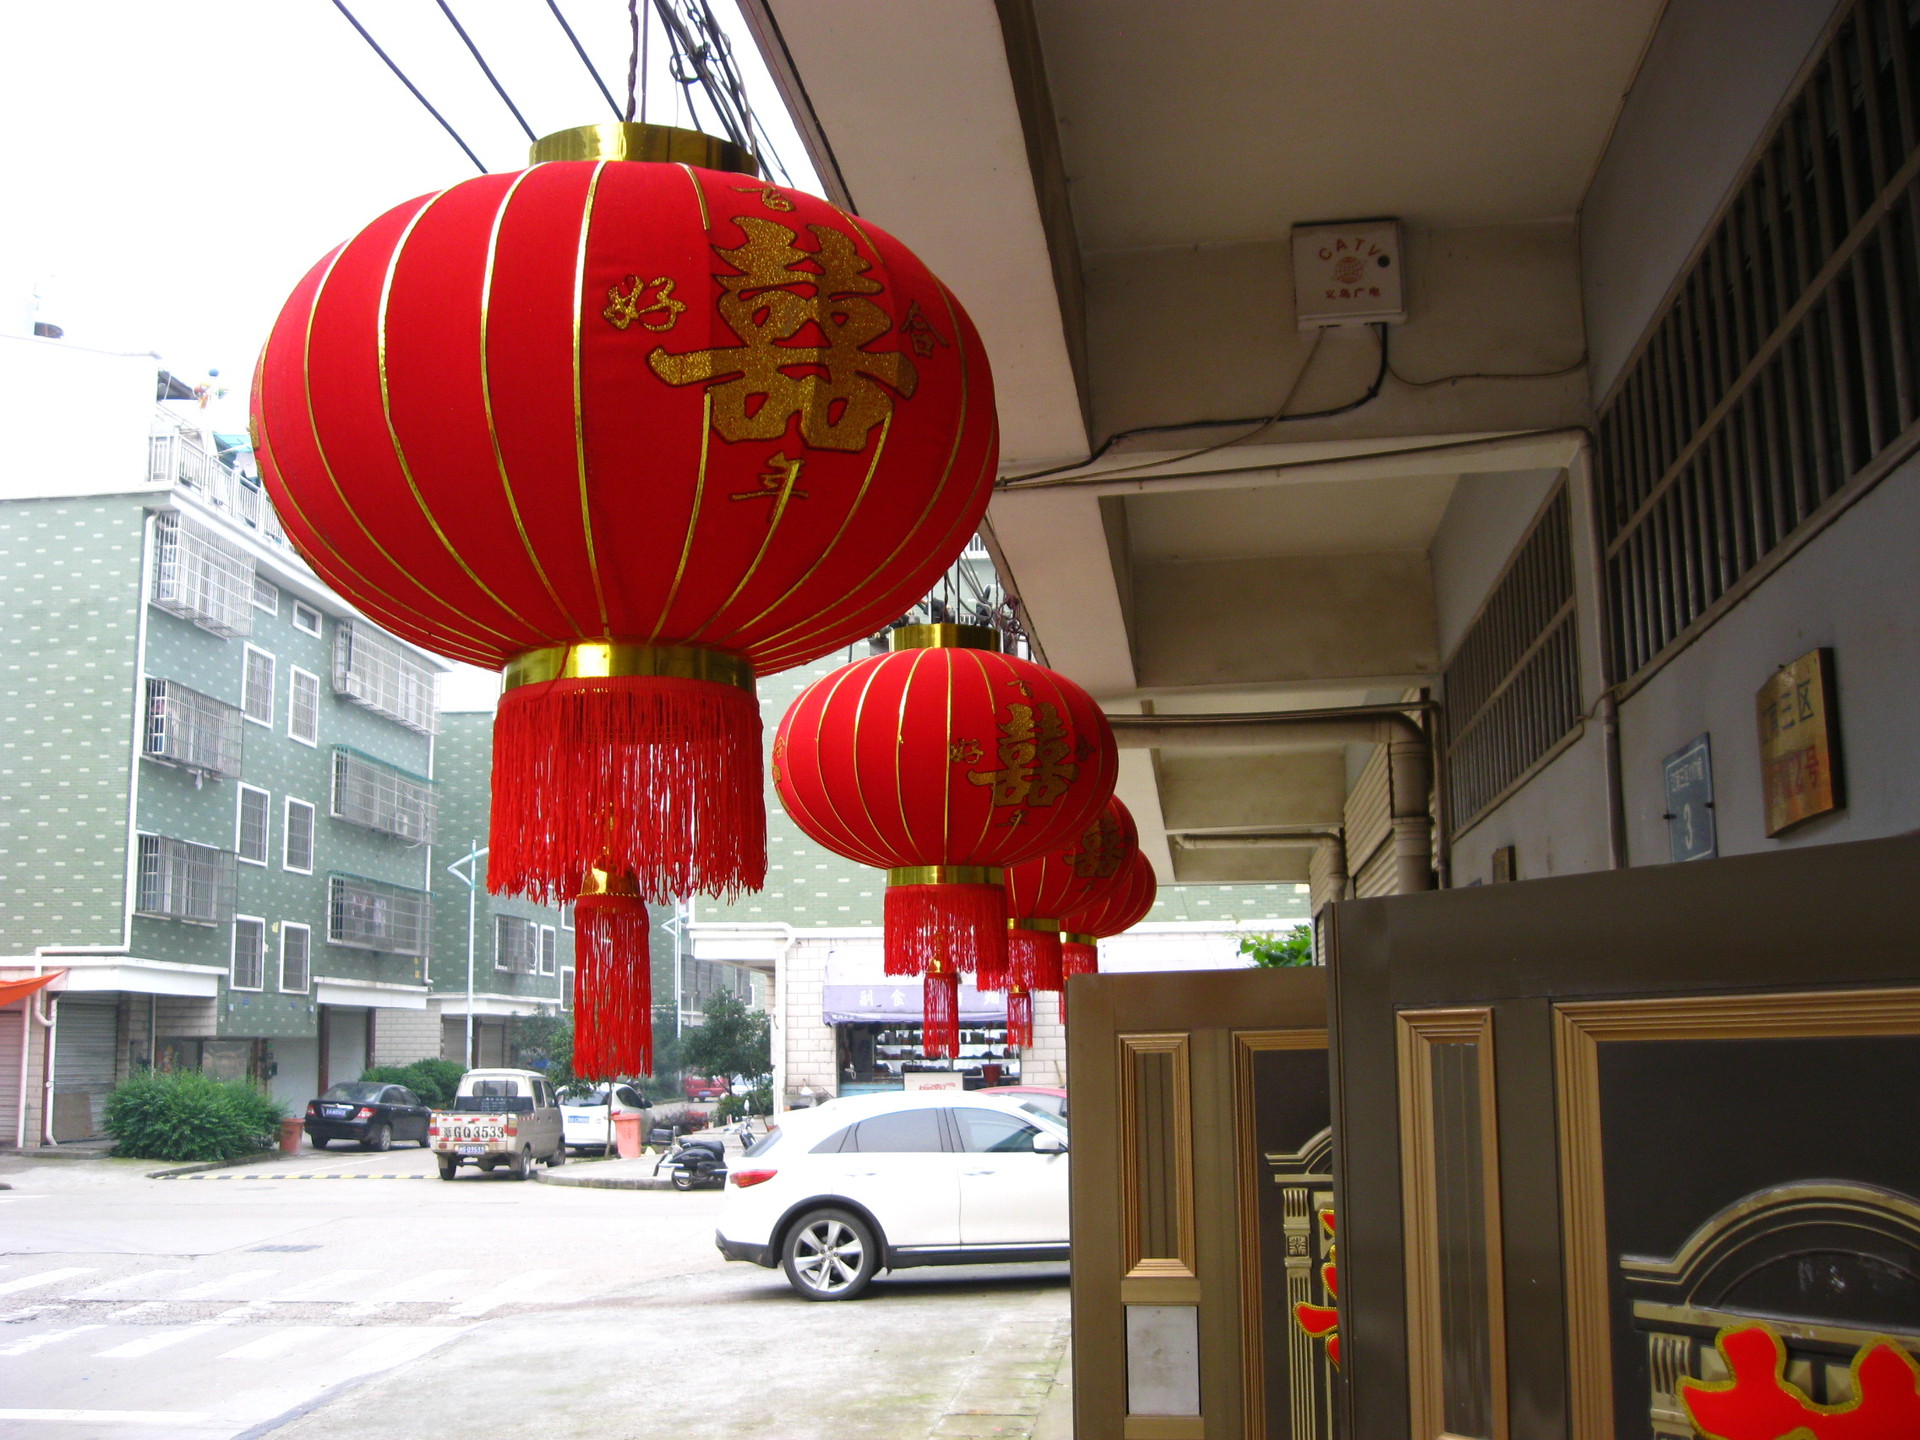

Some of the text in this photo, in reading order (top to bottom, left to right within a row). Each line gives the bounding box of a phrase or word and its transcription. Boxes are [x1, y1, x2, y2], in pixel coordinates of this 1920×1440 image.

[1319, 237, 1383, 262] CATV
[602, 272, 688, 334] 好
[900, 299, 950, 359] 合
[1683, 802, 1693, 851] 3
